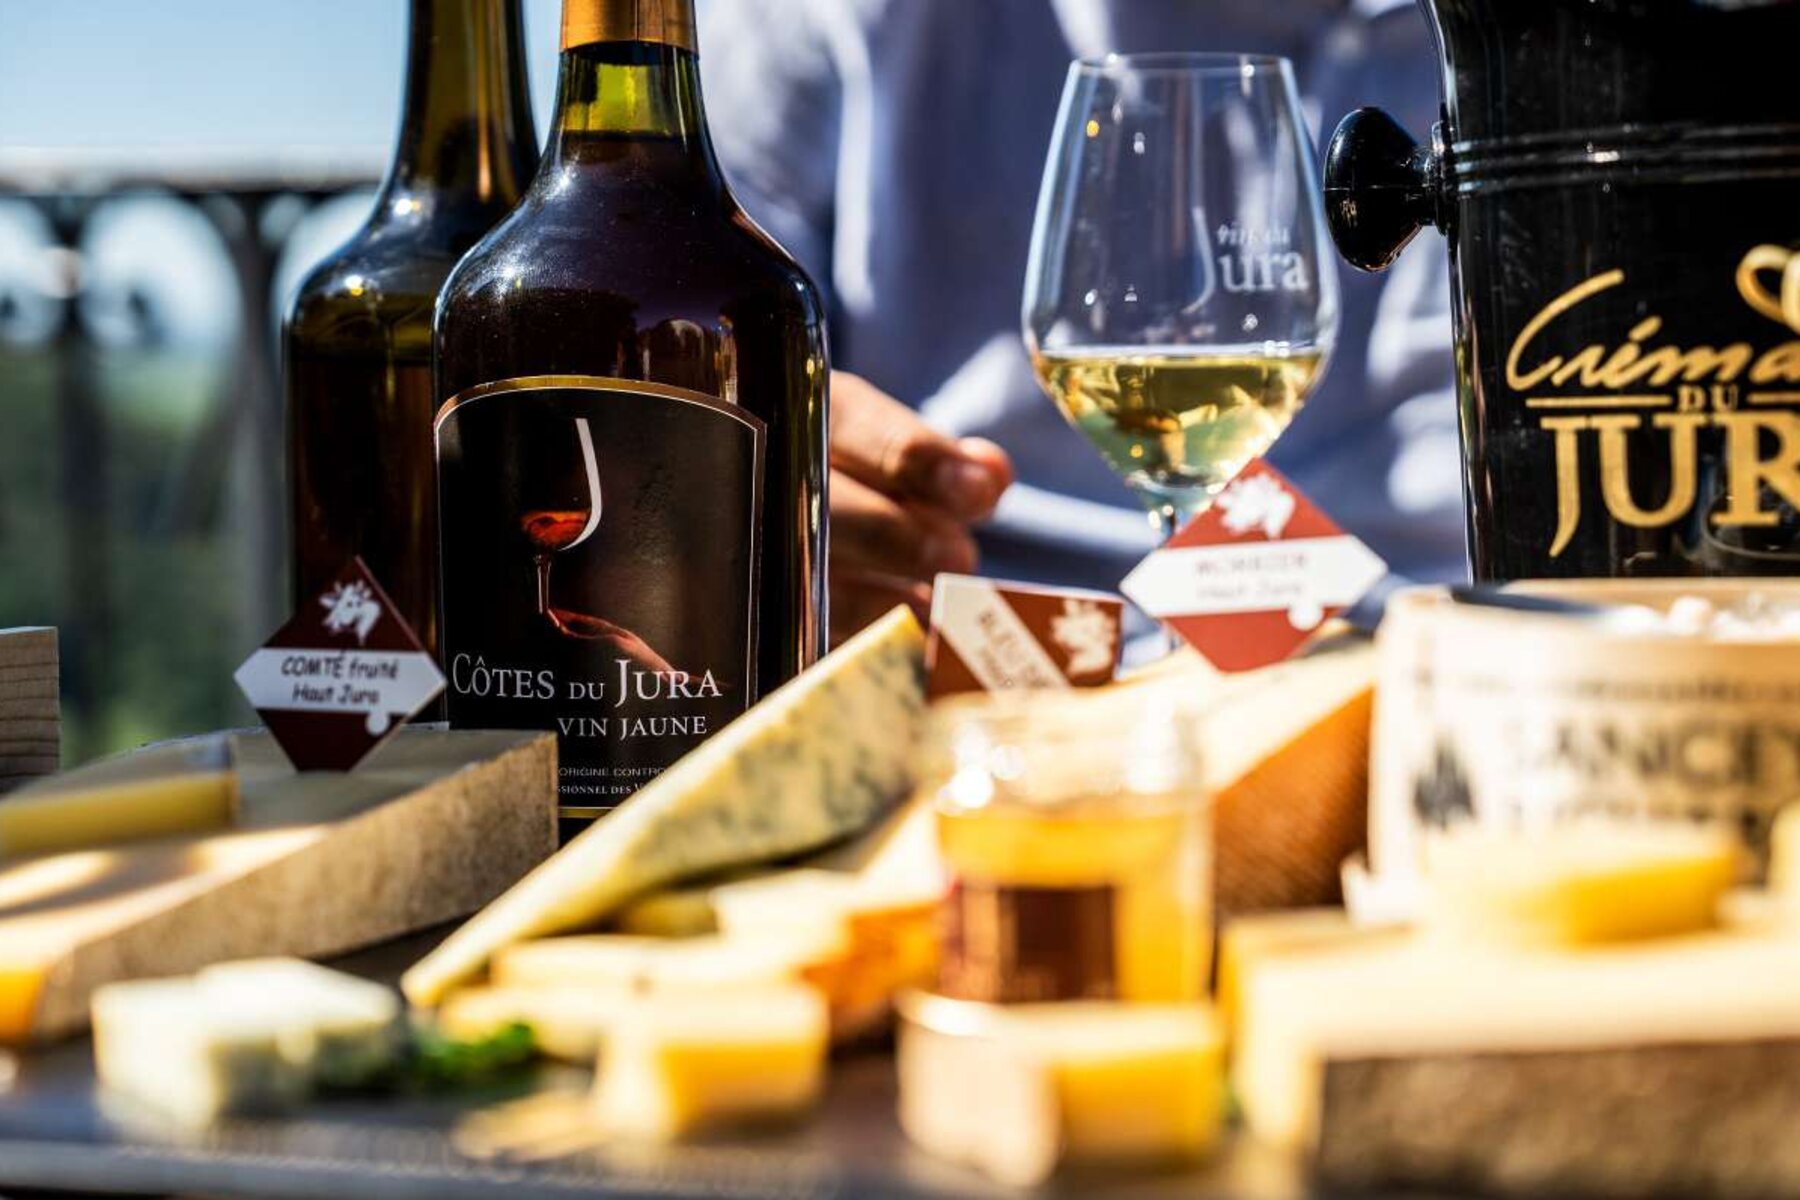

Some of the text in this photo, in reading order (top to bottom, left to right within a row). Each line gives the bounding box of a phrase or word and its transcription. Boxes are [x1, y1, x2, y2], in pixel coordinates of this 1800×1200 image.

[1506, 268, 1800, 391] Créma
[1677, 383, 1739, 414] DU
[1540, 410, 1800, 558] JUR
[281, 650, 344, 678] COMTÉ
[292, 681, 380, 704] Haut Jura
[452, 653, 723, 708] CÔTES DU JURA
[556, 715, 708, 742] VIN JAUNE
[610, 785, 632, 795] DES
